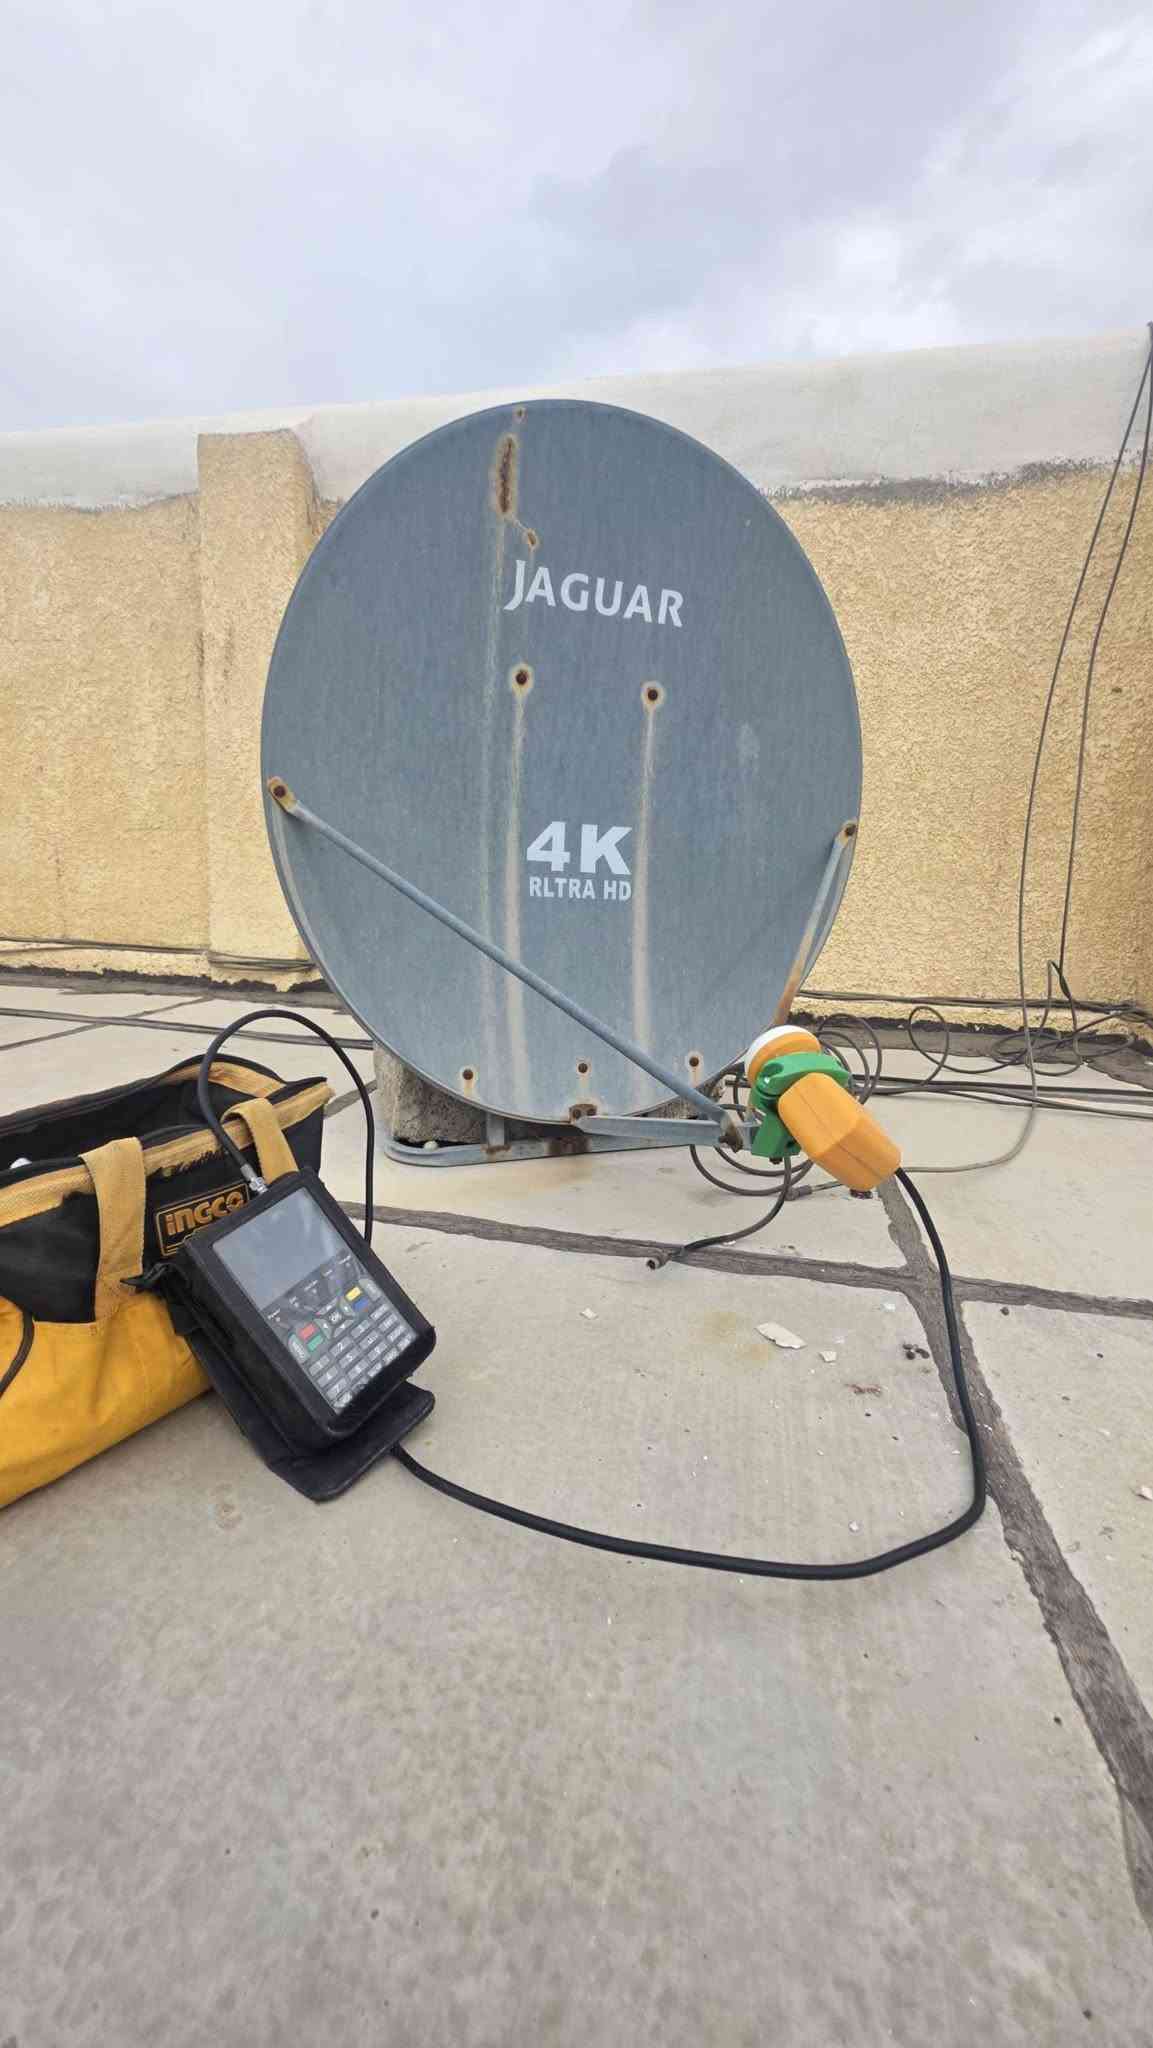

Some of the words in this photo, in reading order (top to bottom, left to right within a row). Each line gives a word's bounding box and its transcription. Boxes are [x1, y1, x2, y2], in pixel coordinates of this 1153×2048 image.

[504, 560, 684, 628] JAGUAR
[526, 821, 632, 875] 4K
[529, 876, 596, 900] RLTRA
[603, 879, 632, 901] HD
